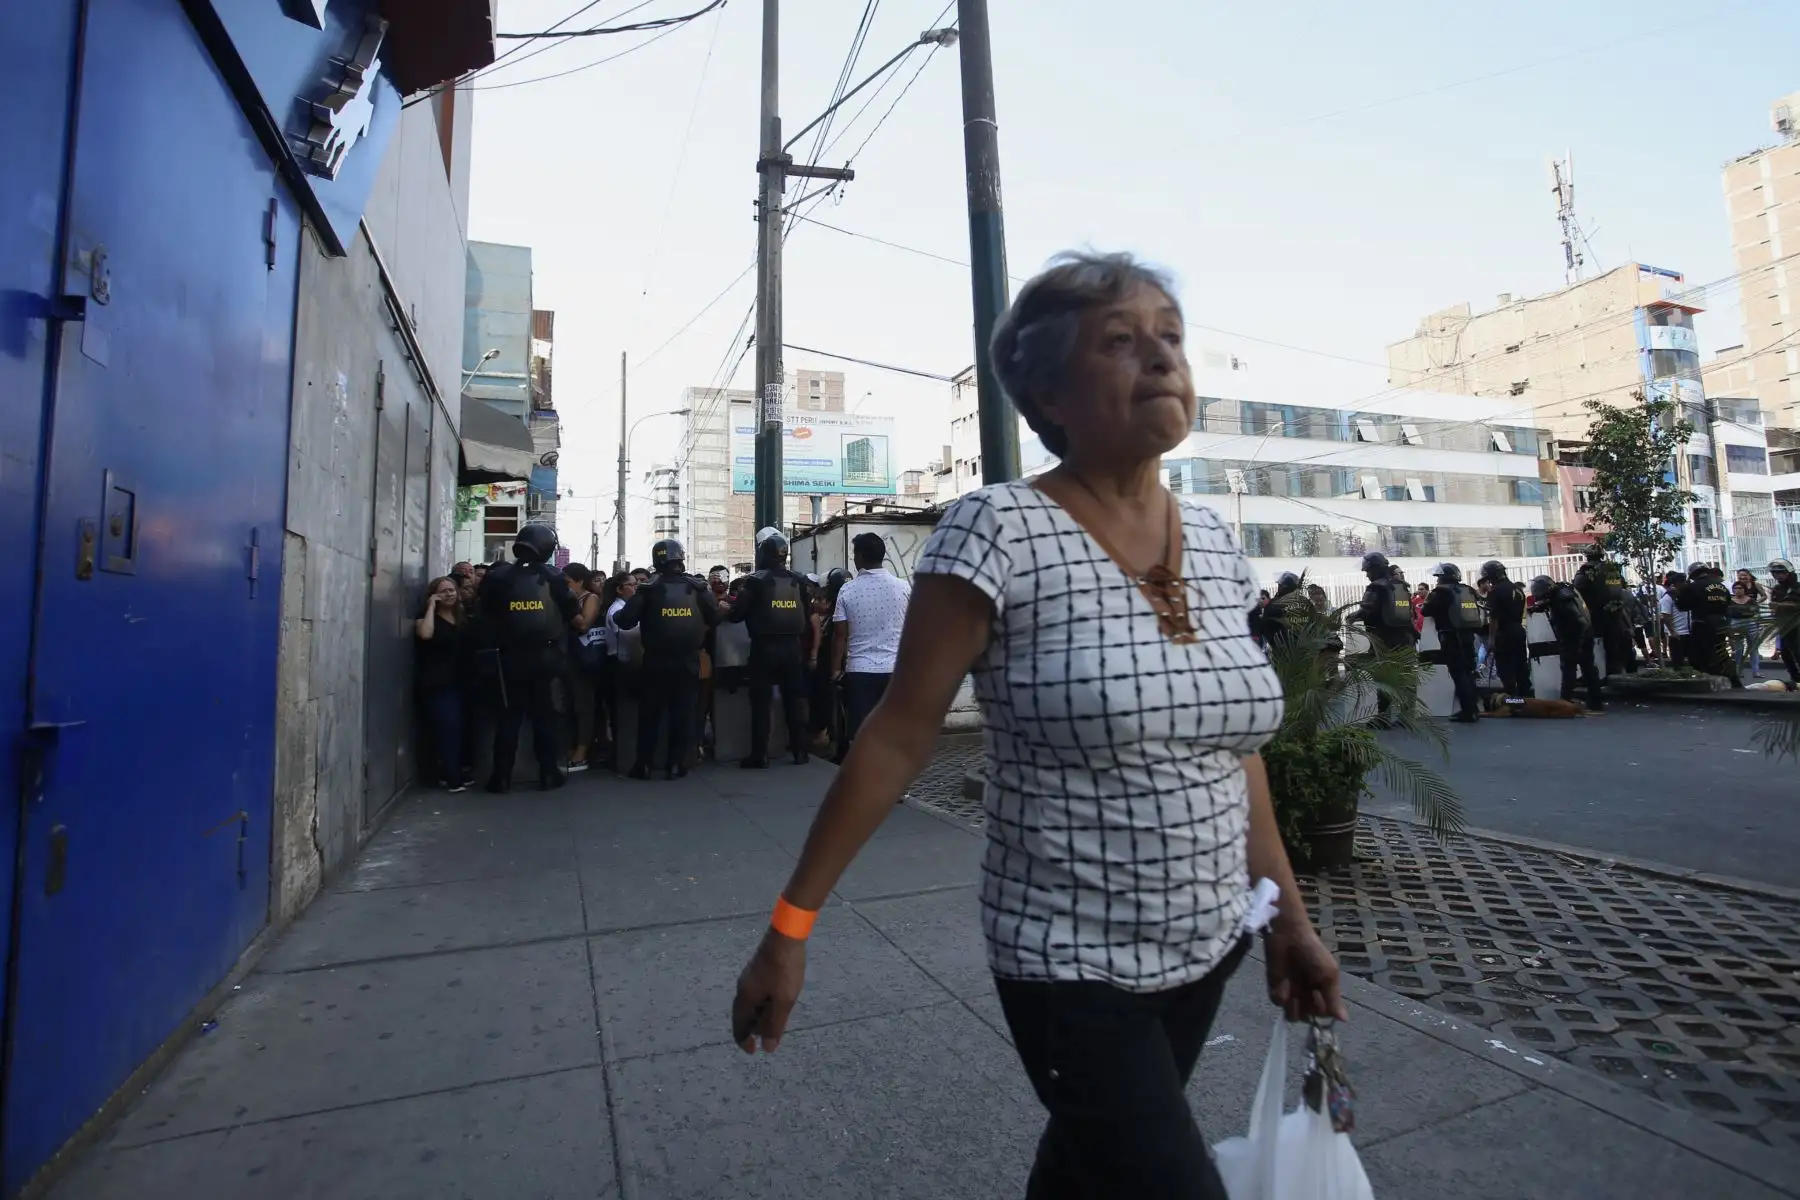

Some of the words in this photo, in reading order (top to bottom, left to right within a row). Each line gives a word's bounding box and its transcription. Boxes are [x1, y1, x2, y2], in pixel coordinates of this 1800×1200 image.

[510, 600, 544, 610] POLICIA
[771, 600, 797, 608] POLICIA
[661, 607, 692, 616] POLICIA
